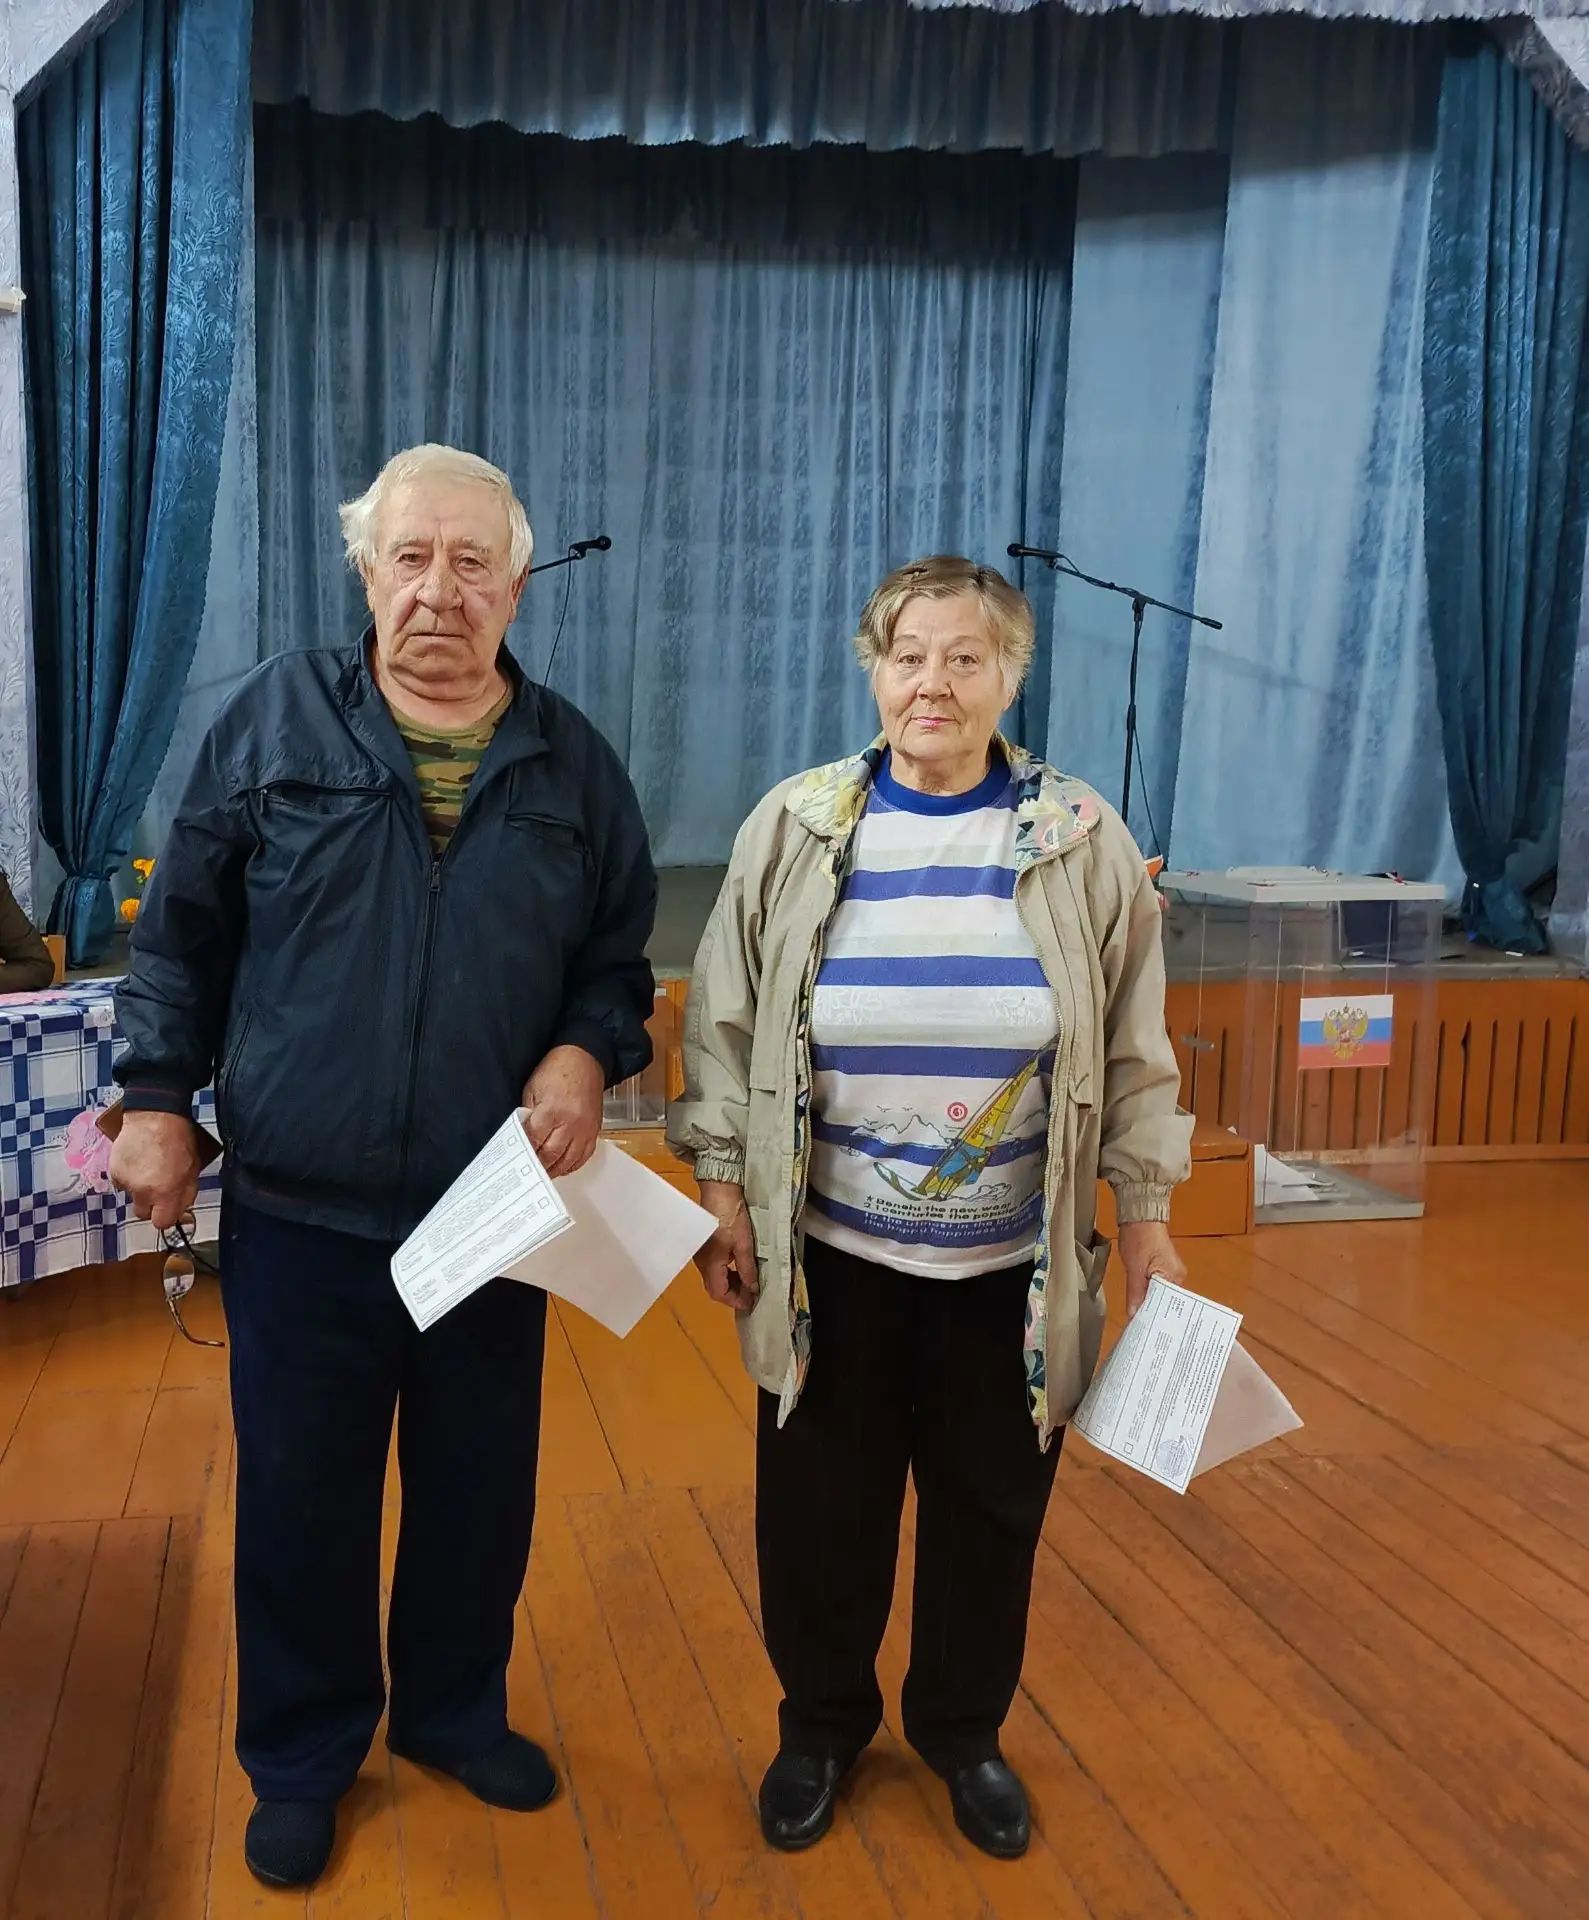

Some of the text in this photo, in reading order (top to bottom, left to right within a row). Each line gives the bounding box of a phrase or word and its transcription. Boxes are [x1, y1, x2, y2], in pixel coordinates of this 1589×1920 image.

[926, 1205, 946, 1213] the
[882, 1215, 902, 1225] the
[949, 1212, 969, 1220] the
